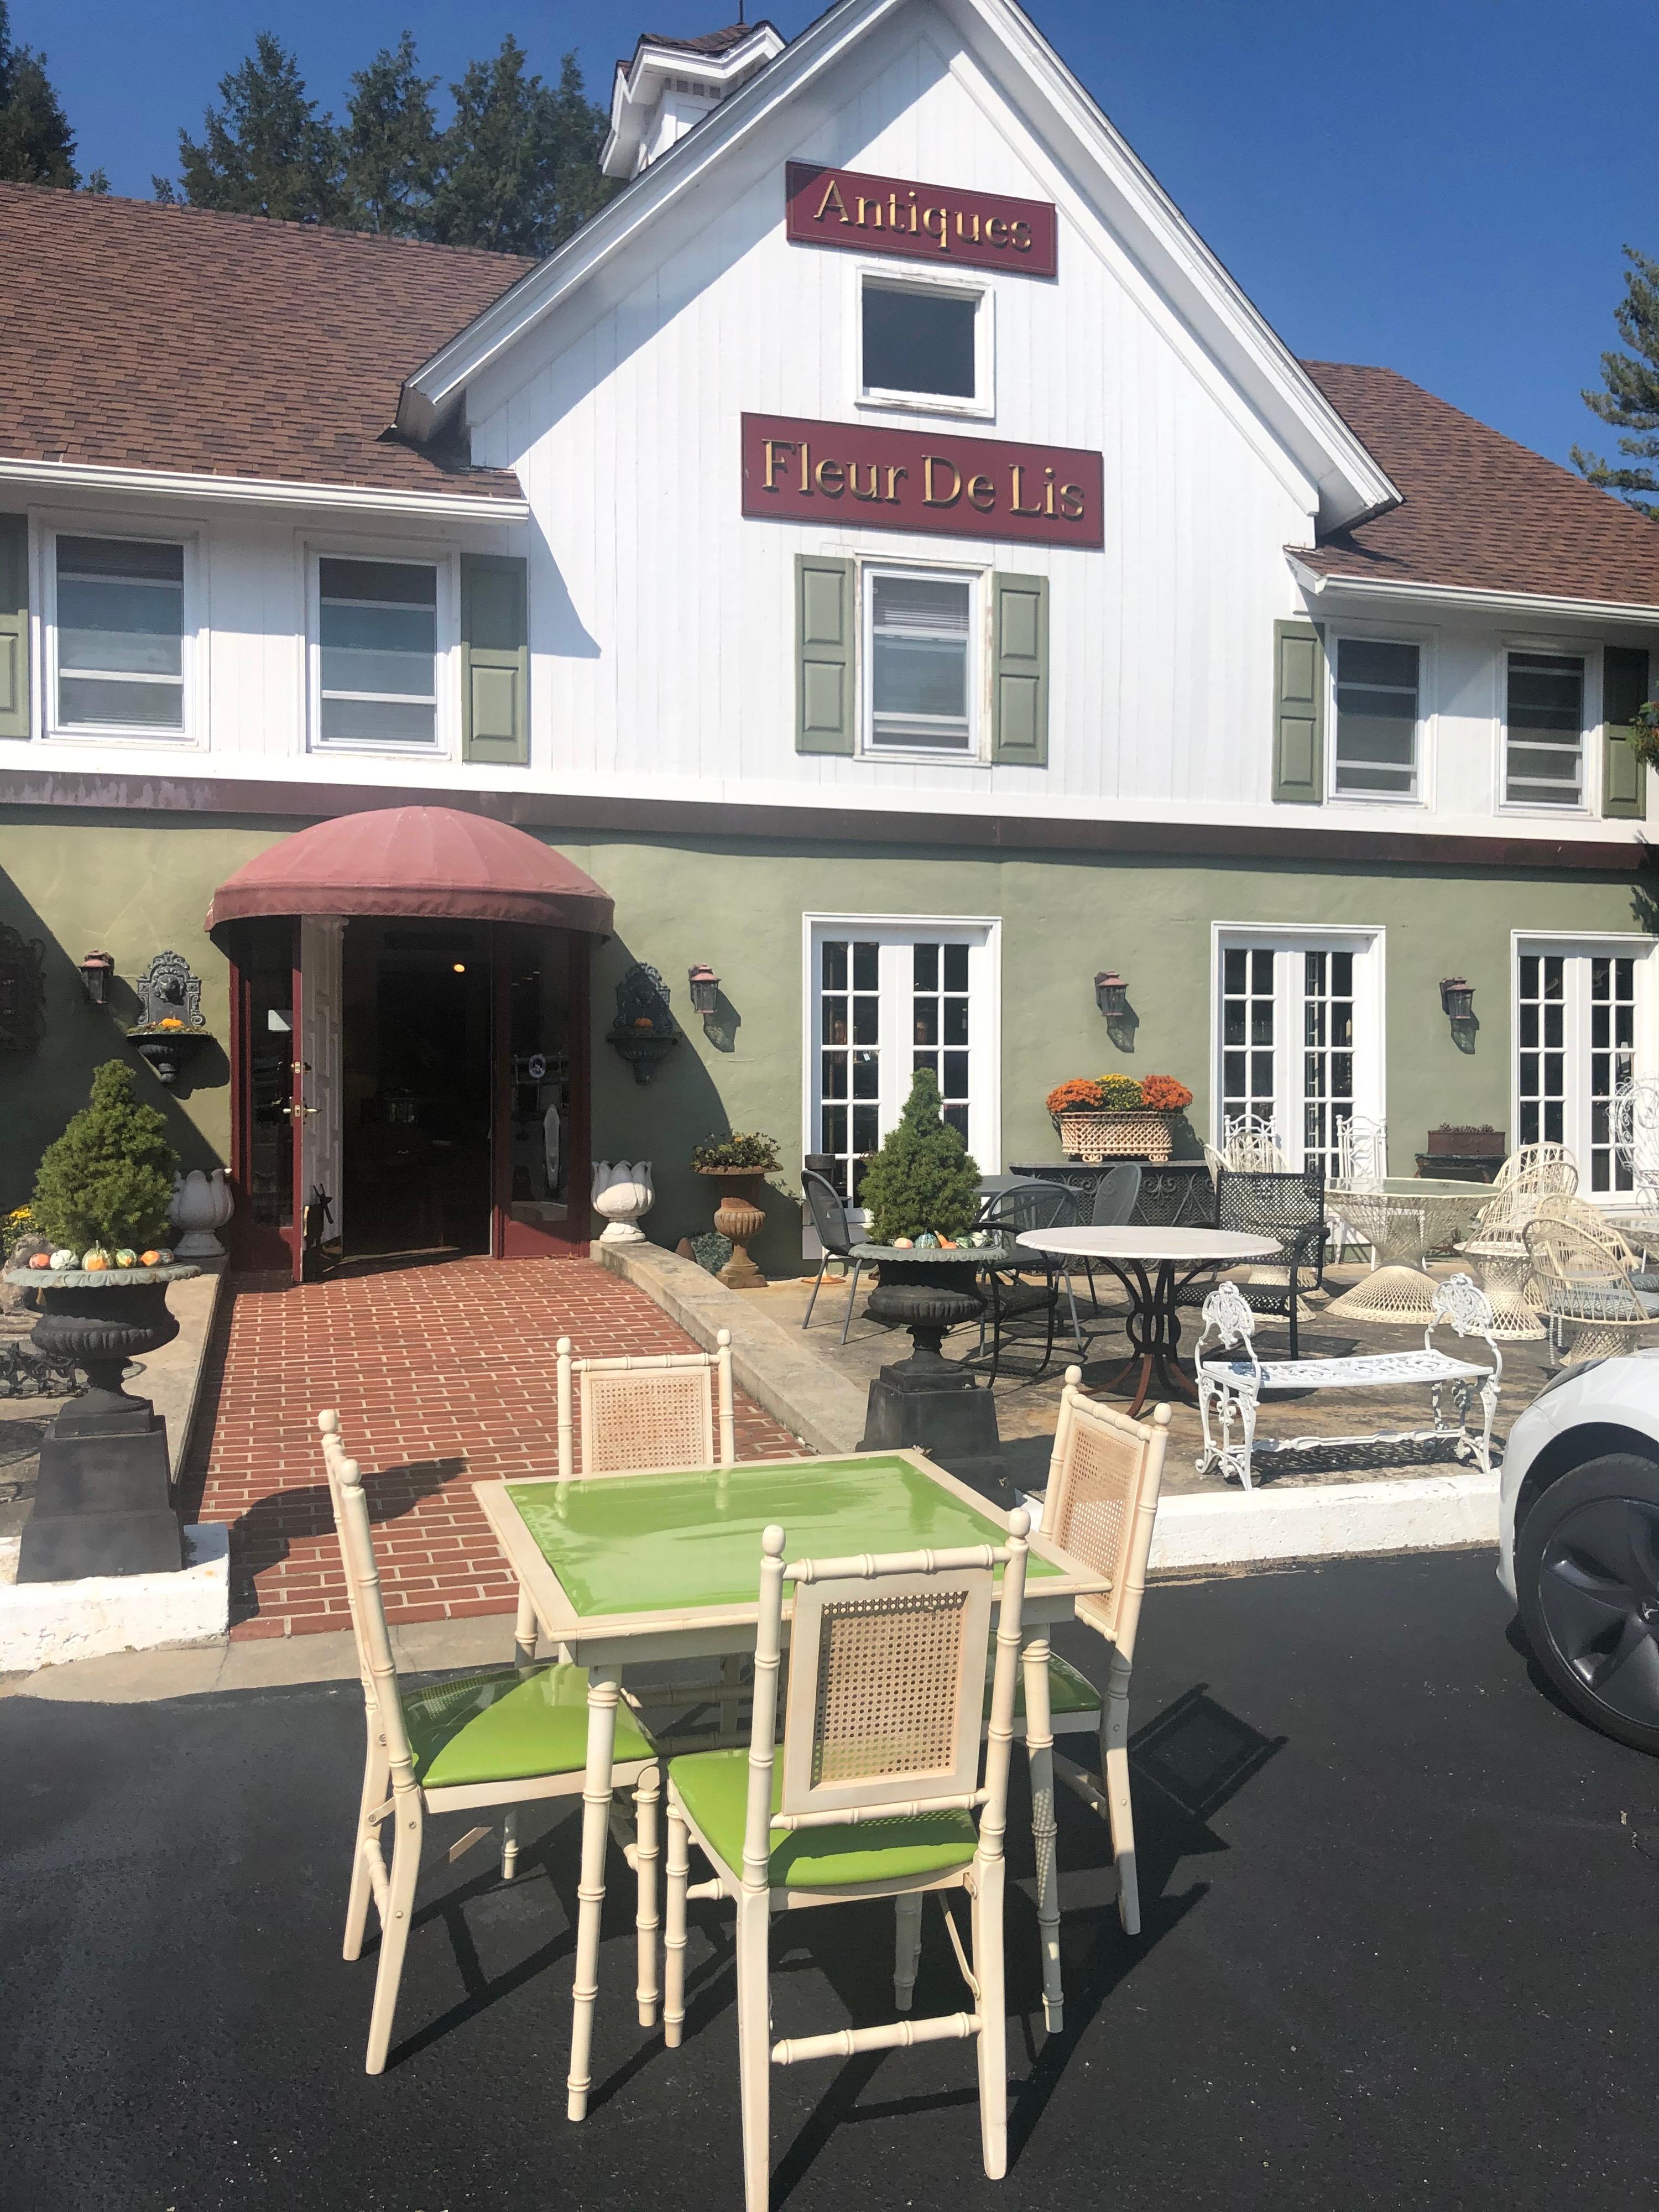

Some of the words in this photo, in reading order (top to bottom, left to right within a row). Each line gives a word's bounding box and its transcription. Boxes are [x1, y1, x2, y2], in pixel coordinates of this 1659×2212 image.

[812, 179, 1032, 251] Antiques
[761, 439, 909, 503] Fleur
[920, 454, 995, 510] De
[1008, 463, 1085, 518] Lis
